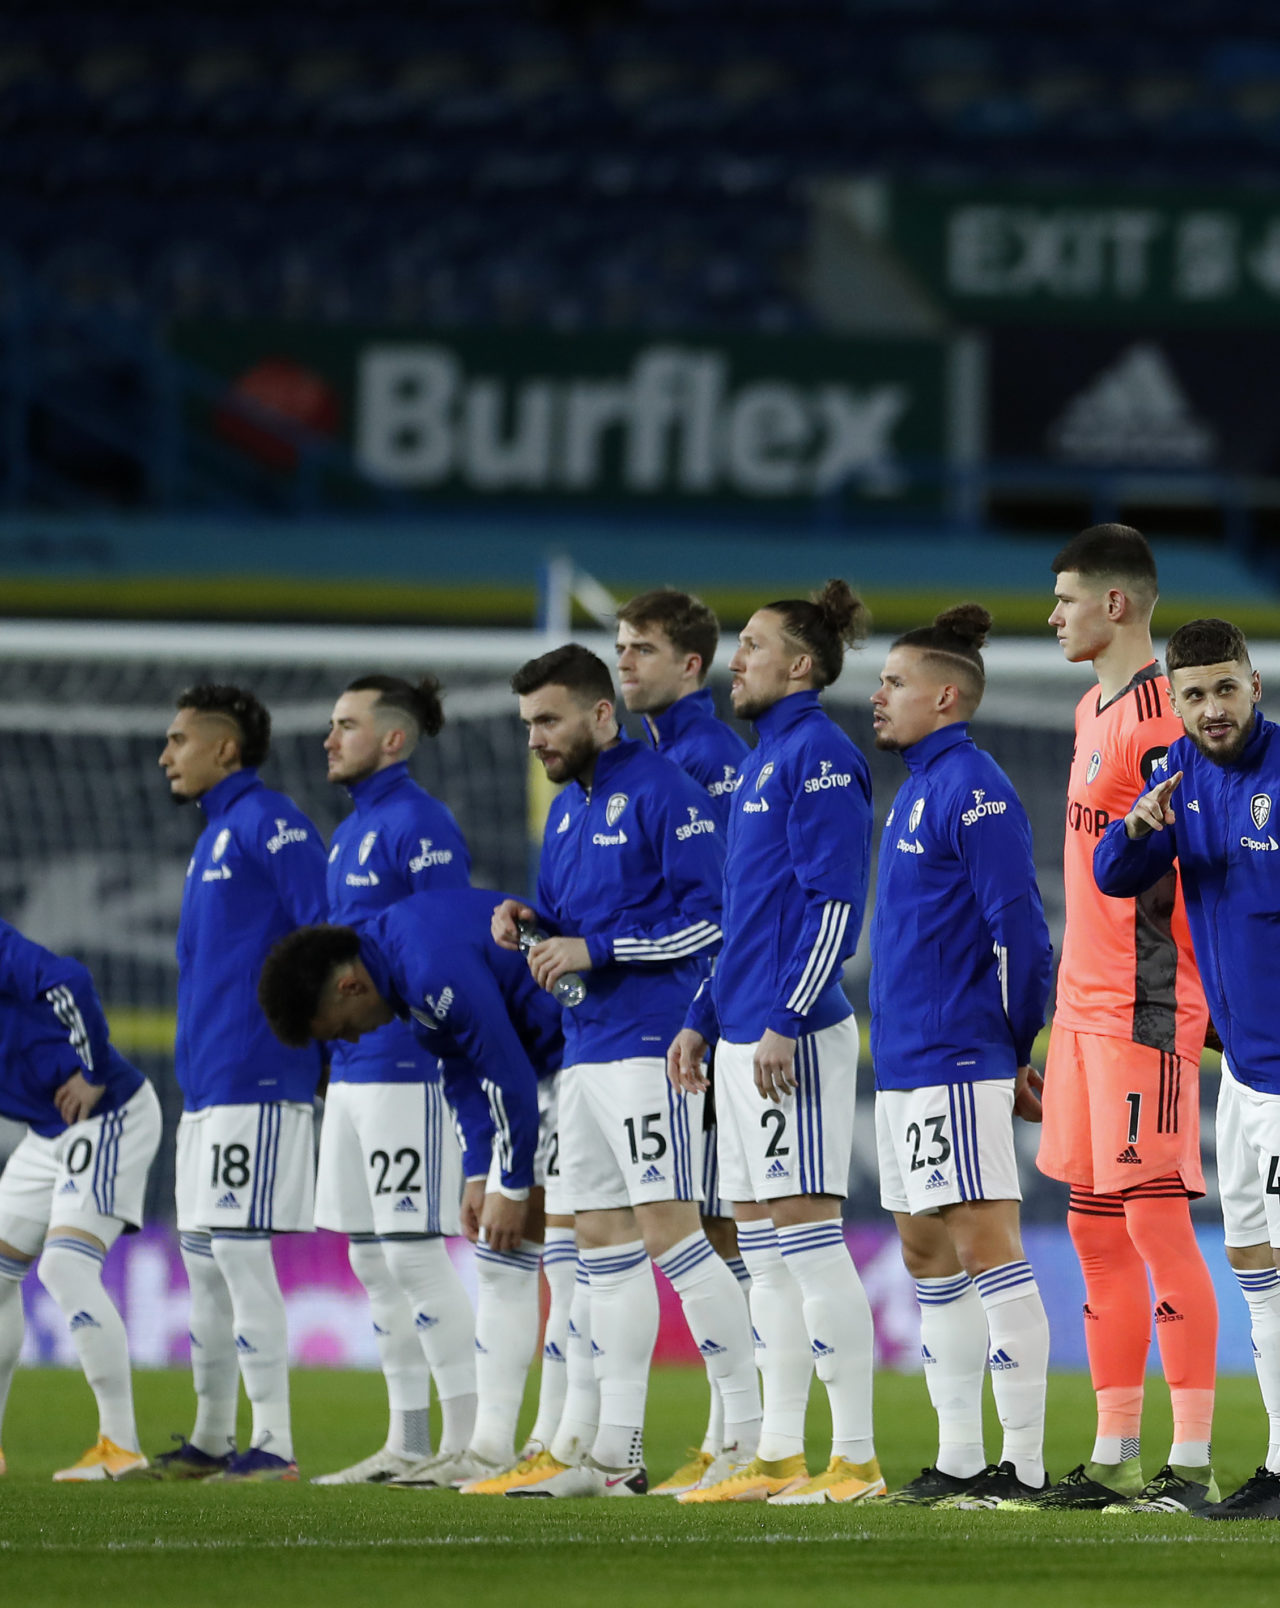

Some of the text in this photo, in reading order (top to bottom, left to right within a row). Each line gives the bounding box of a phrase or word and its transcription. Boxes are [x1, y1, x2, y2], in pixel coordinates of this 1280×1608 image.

[948, 206, 1158, 296] EXIT
[357, 346, 904, 492] Burflex
[803, 773, 852, 794] SBOTOP
[961, 801, 1008, 827] SBOTOP
[1240, 836, 1270, 852] Clipper
[623, 1112, 667, 1165] 15
[761, 1108, 790, 1158] 2
[1125, 1091, 1142, 1145] 1
[211, 1143, 250, 1190] 18
[906, 1114, 951, 1173] 23
[1116, 1156, 1143, 1165] adidas
[370, 1147, 422, 1197] 22
